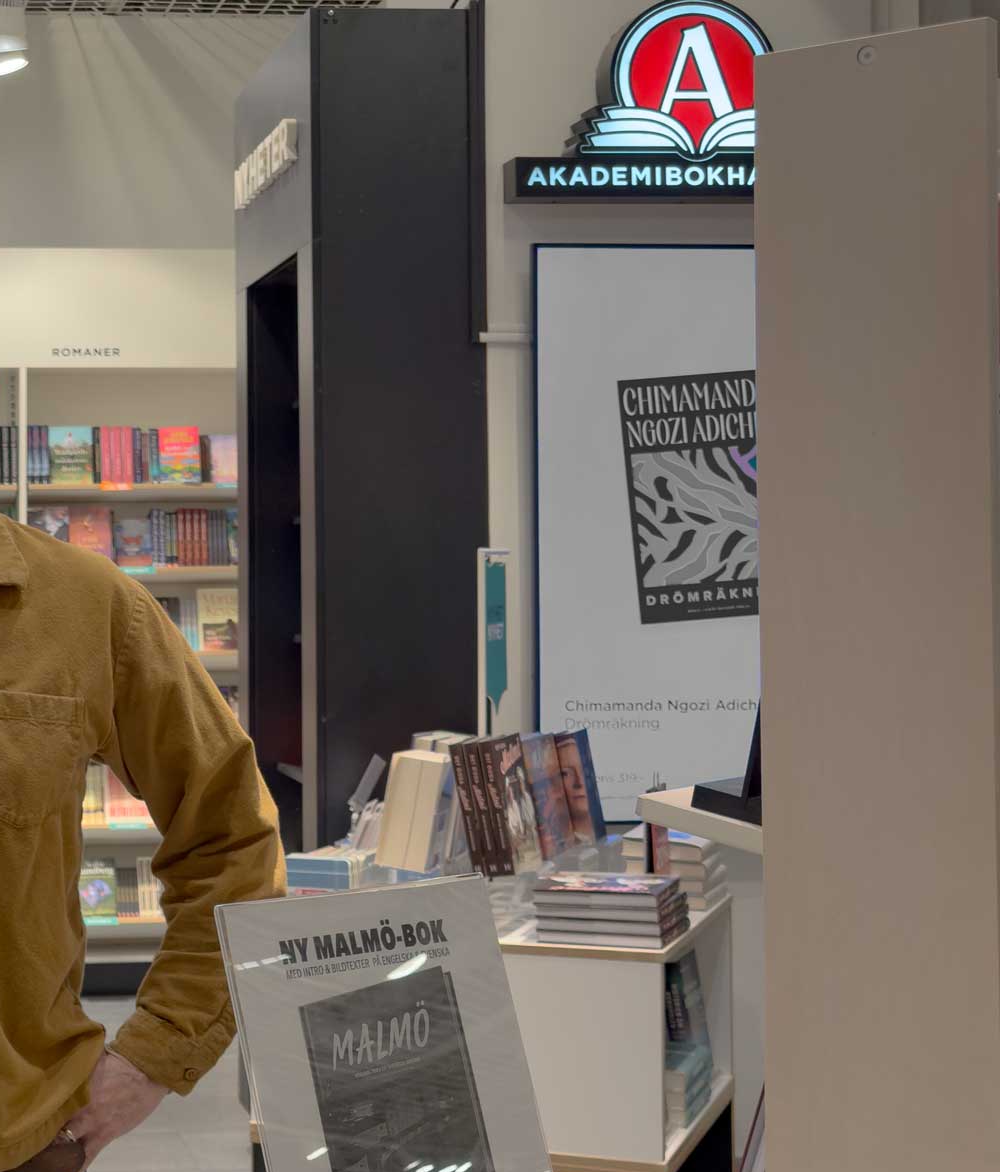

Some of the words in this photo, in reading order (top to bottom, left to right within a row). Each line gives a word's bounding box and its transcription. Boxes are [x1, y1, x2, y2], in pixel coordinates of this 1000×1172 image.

[659, 22, 734, 119] A
[527, 166, 755, 187] AKADEMIBOKHA
[51, 347, 121, 357] ROMANER
[622, 379, 757, 417] CHIMAMAND
[626, 416, 688, 448] NGOZI
[692, 411, 757, 444] ADICH
[646, 587, 758, 606] DRÖMRÄKN
[564, 699, 662, 712] Chimamanda
[667, 699, 711, 714] Ngozi
[716, 698, 757, 712] Adich
[279, 937, 309, 965] NY
[312, 918, 448, 960] MALMÖ-BOK
[286, 968, 303, 980] MED
[303, 966, 324, 977] INTRO
[325, 966, 331, 975] &
[331, 958, 369, 973] BILDTEXTER
[373, 954, 382, 967] PÅ
[383, 951, 413, 966] ENGELSKA
[332, 1000, 430, 1071] MALMÖ
